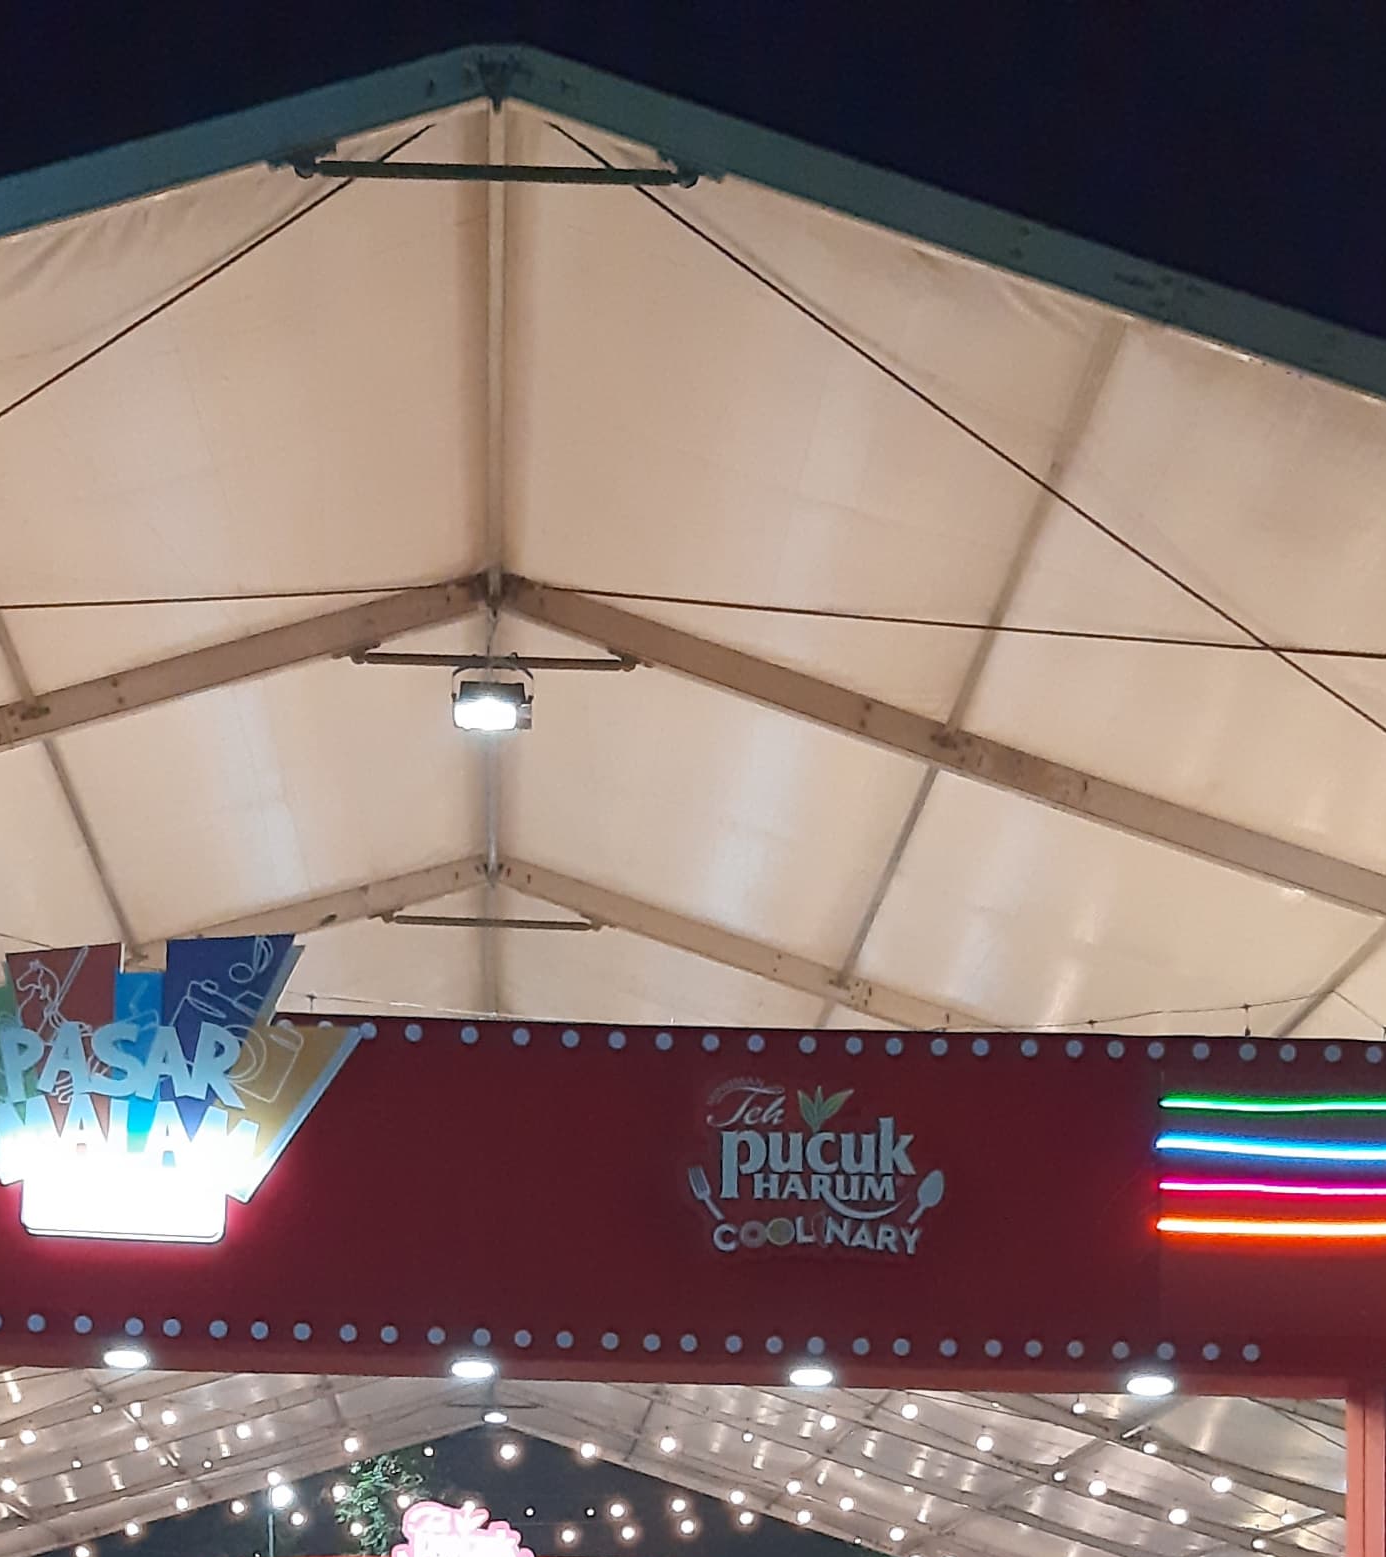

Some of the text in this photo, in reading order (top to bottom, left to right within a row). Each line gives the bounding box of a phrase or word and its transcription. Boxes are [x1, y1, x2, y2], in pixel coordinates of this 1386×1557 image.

[706, 1086, 786, 1127] Teh
[720, 1116, 916, 1199] pucuk
[753, 1173, 900, 1208] HARUM
